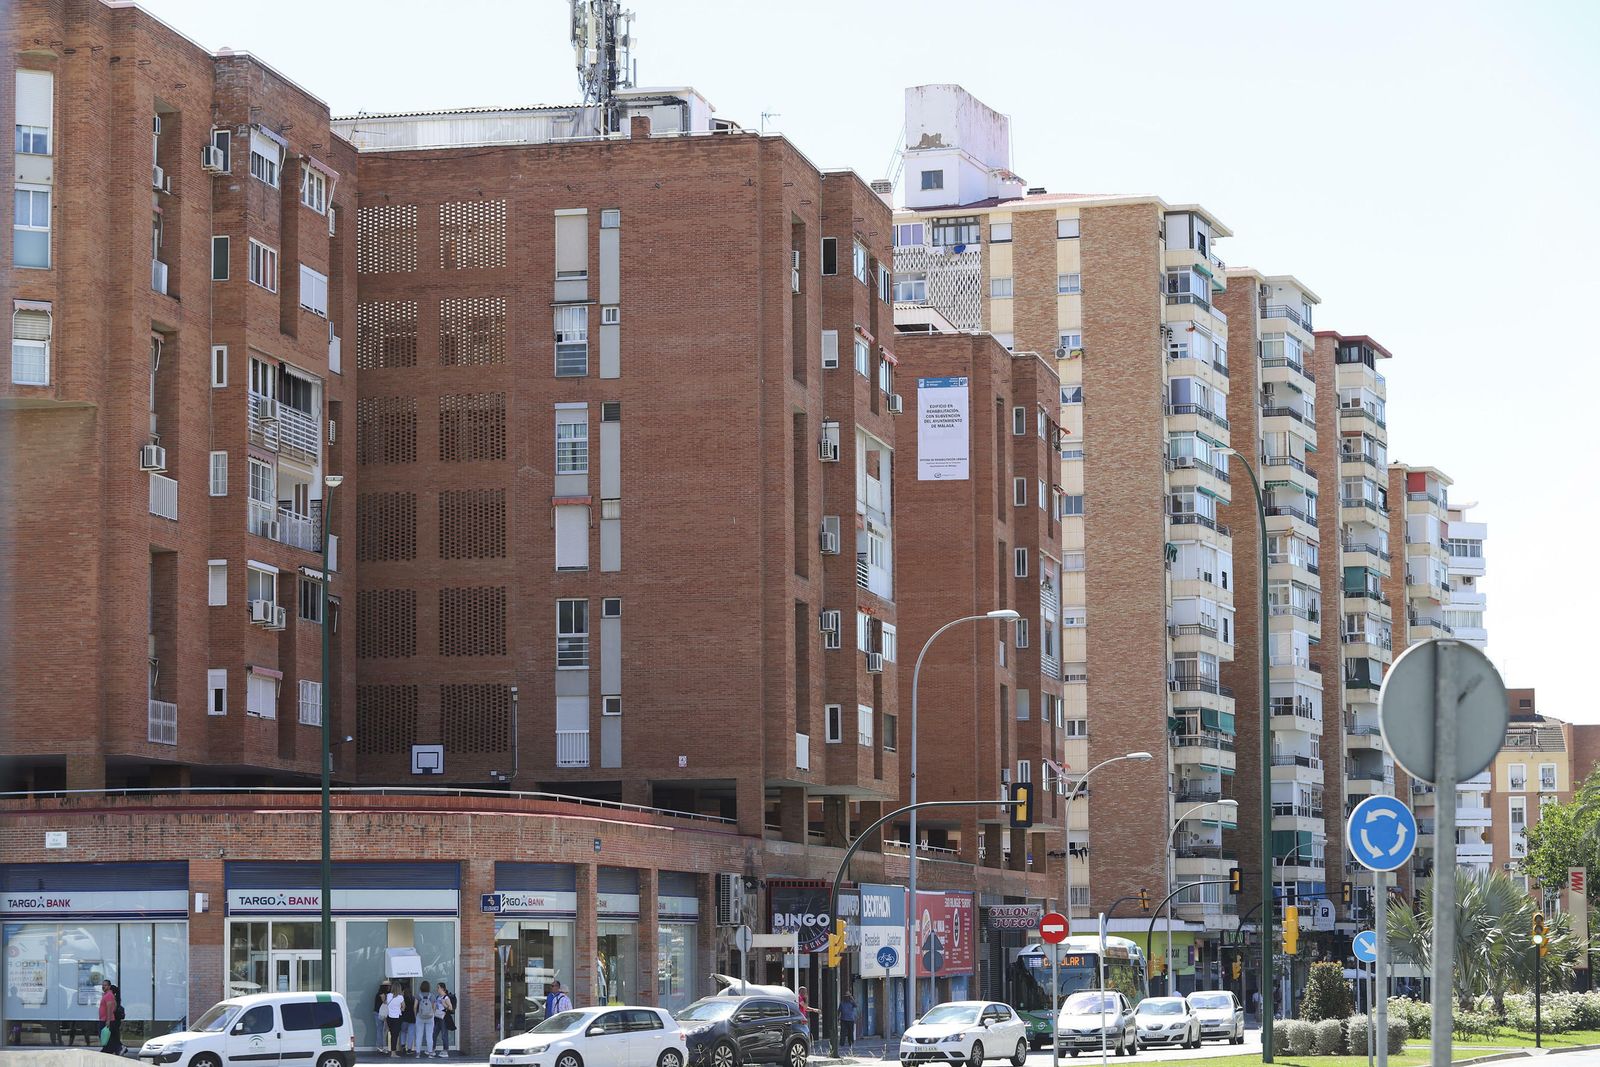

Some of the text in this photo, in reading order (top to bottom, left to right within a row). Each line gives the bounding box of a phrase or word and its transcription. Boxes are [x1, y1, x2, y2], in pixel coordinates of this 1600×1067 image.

[8, 900, 71, 908] TARGO BANK
[238, 896, 319, 906] TARGO BANK
[528, 898, 544, 906] BANK
[862, 895, 890, 918] DECATHLON
[989, 907, 1029, 916] SALON
[774, 913, 830, 927] BINGO
[993, 918, 1035, 928] JUEGO
